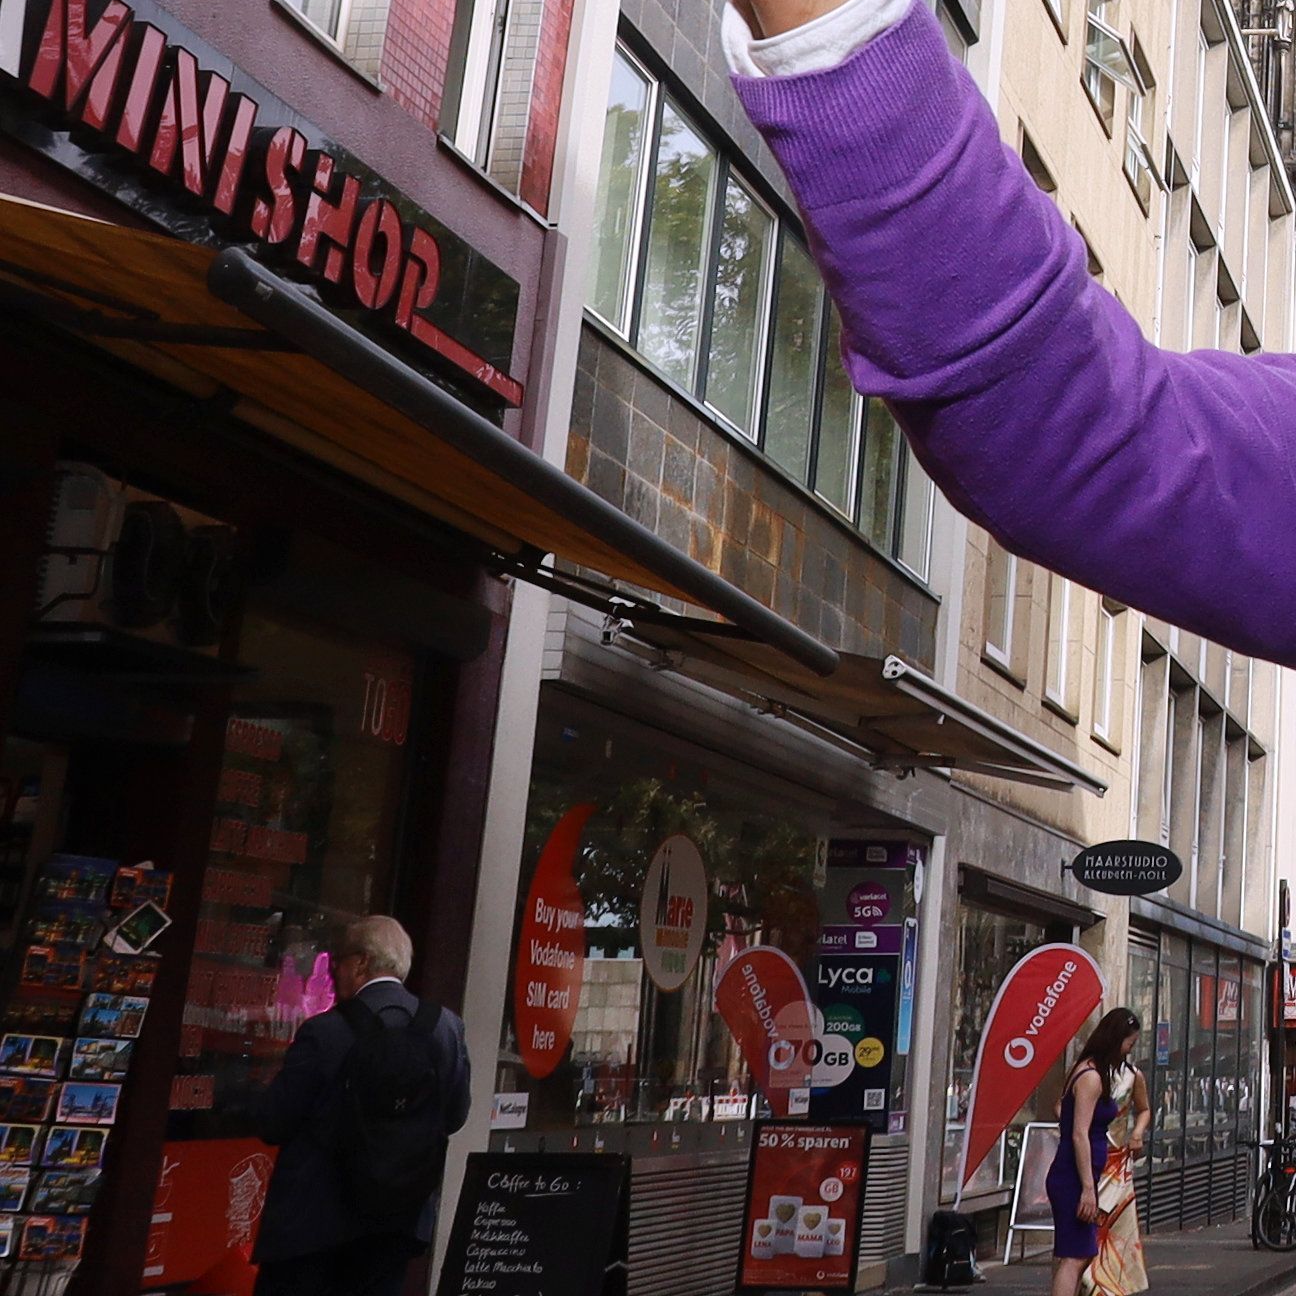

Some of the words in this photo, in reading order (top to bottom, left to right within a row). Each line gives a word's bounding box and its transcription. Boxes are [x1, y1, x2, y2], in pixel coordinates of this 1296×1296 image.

[251, 126, 460, 344] SHOP
[1085, 855, 1168, 868] HAARSTUDIO
[535, 897, 557, 932] Buy
[556, 907, 580, 933] your
[854, 905, 872, 918] 5G
[530, 939, 575, 970] Vodafone
[818, 964, 874, 988] Lyca
[526, 981, 547, 1007] SIM
[547, 986, 570, 1009] card
[1025, 961, 1078, 1035] vodafone
[532, 1024, 556, 1050] here
[758, 1133, 778, 1148] 50
[781, 1133, 795, 1148] %
[535, 1176, 547, 1190] to
